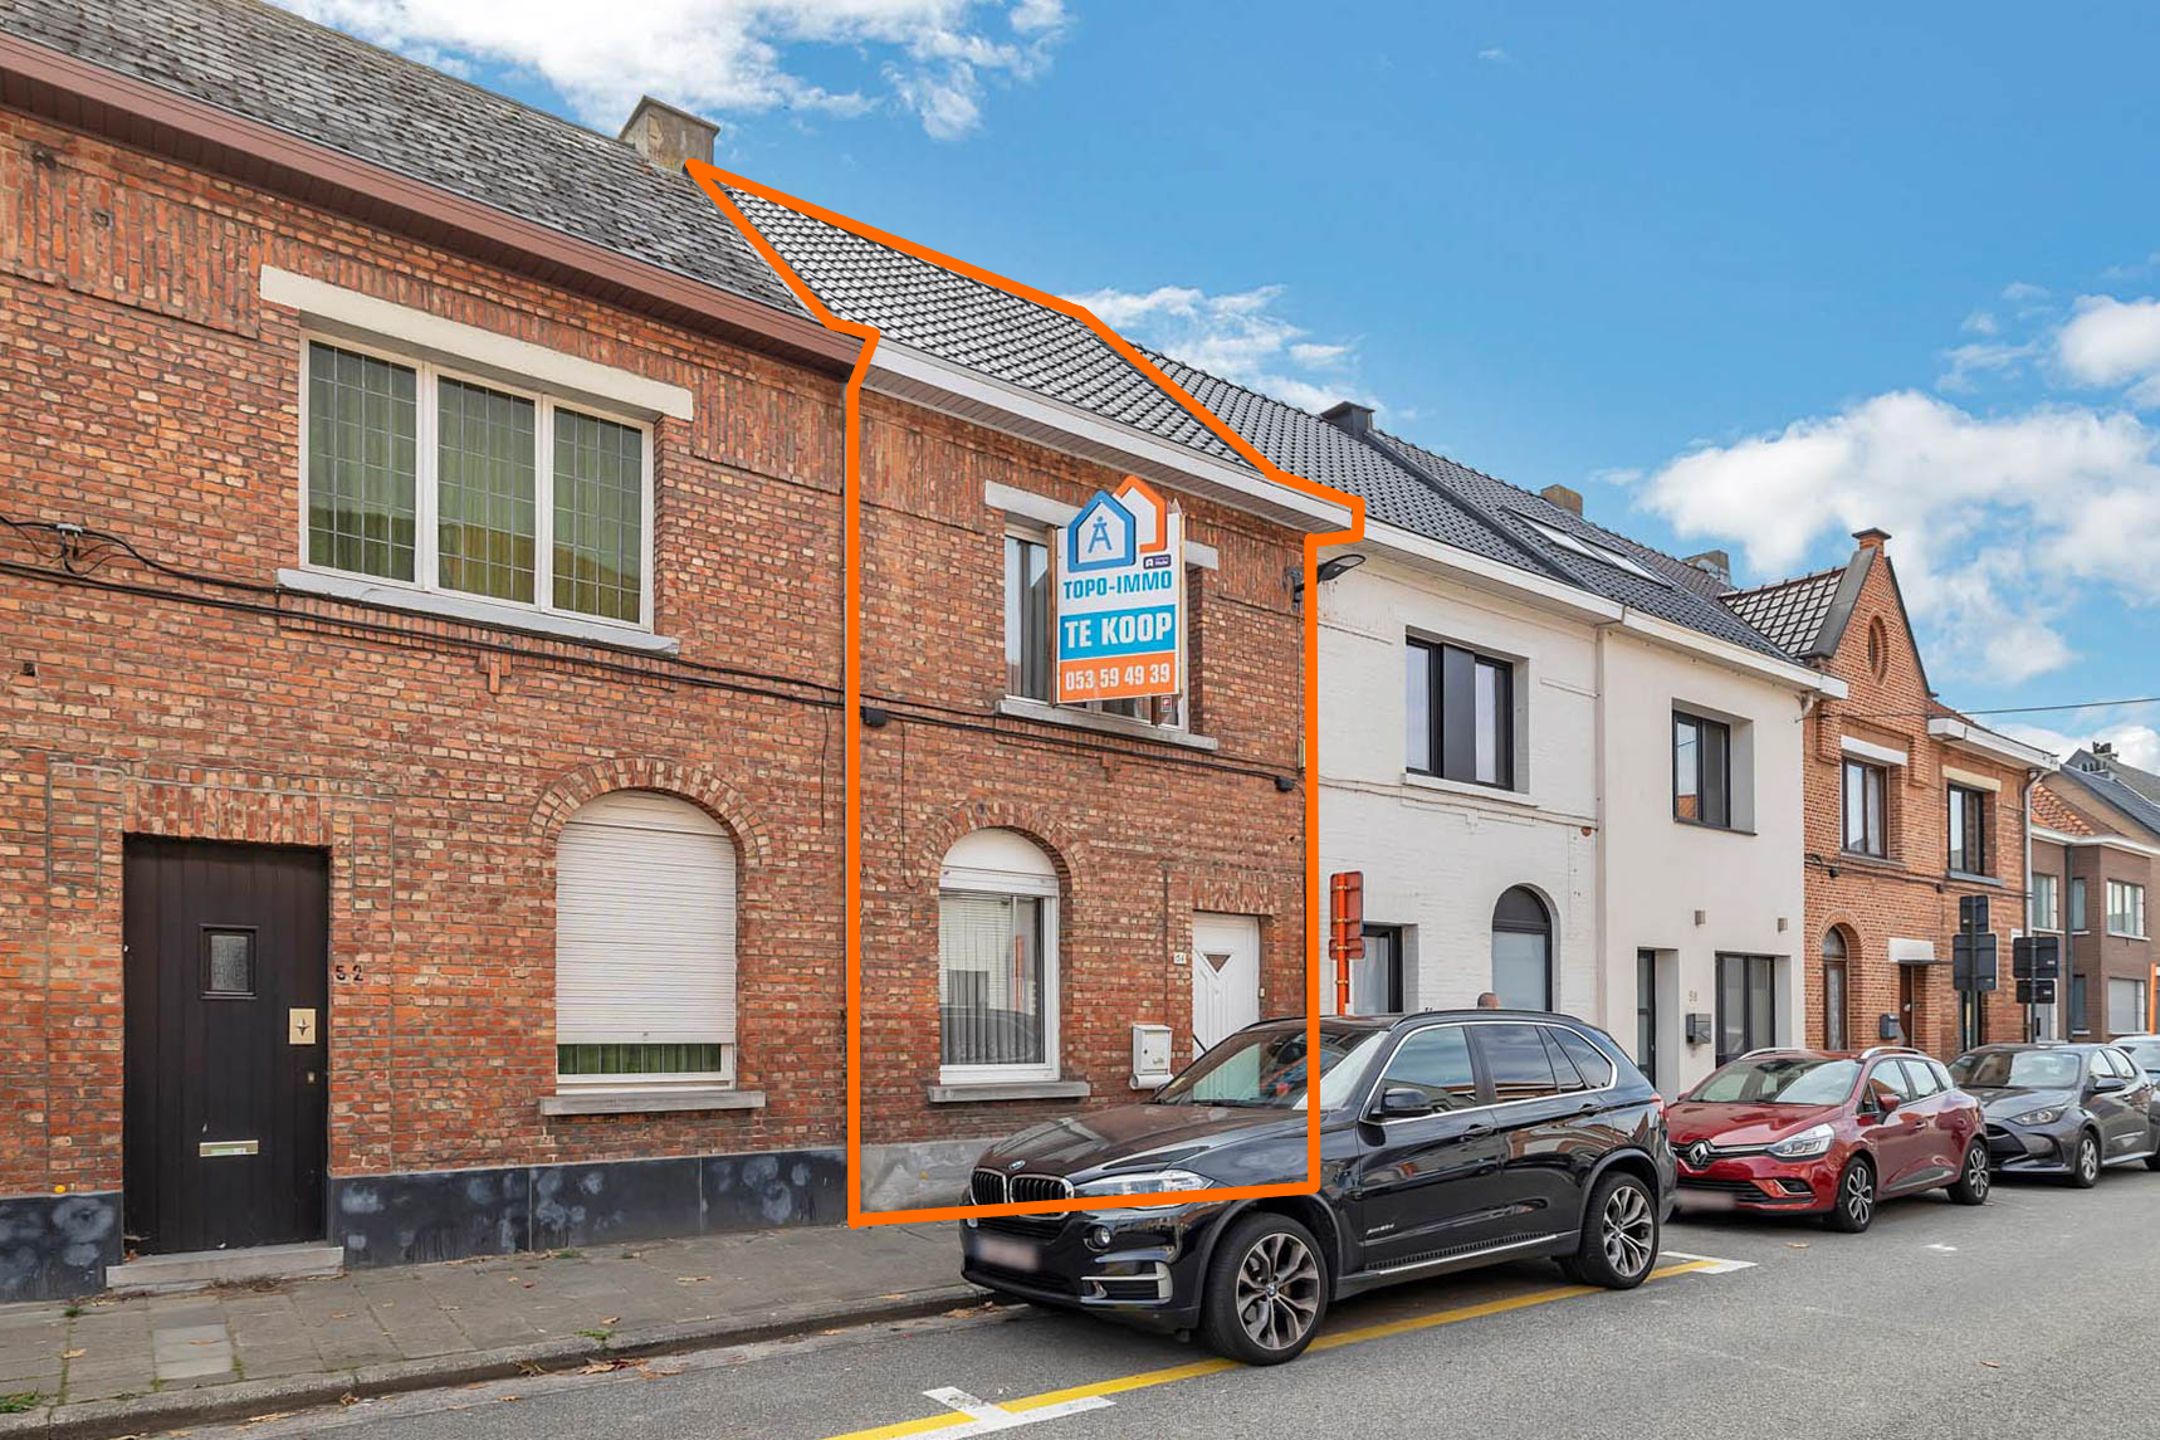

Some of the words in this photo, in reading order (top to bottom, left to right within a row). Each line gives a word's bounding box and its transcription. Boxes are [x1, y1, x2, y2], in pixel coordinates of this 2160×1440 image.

[1063, 570, 1172, 600] TOPO-IMMO
[1065, 620, 1092, 649] TE
[1102, 612, 1172, 645] KOOP
[1065, 670, 1094, 691] 053
[1100, 667, 1120, 688] 59
[1124, 665, 1144, 686] 49
[1150, 663, 1170, 684] 39
